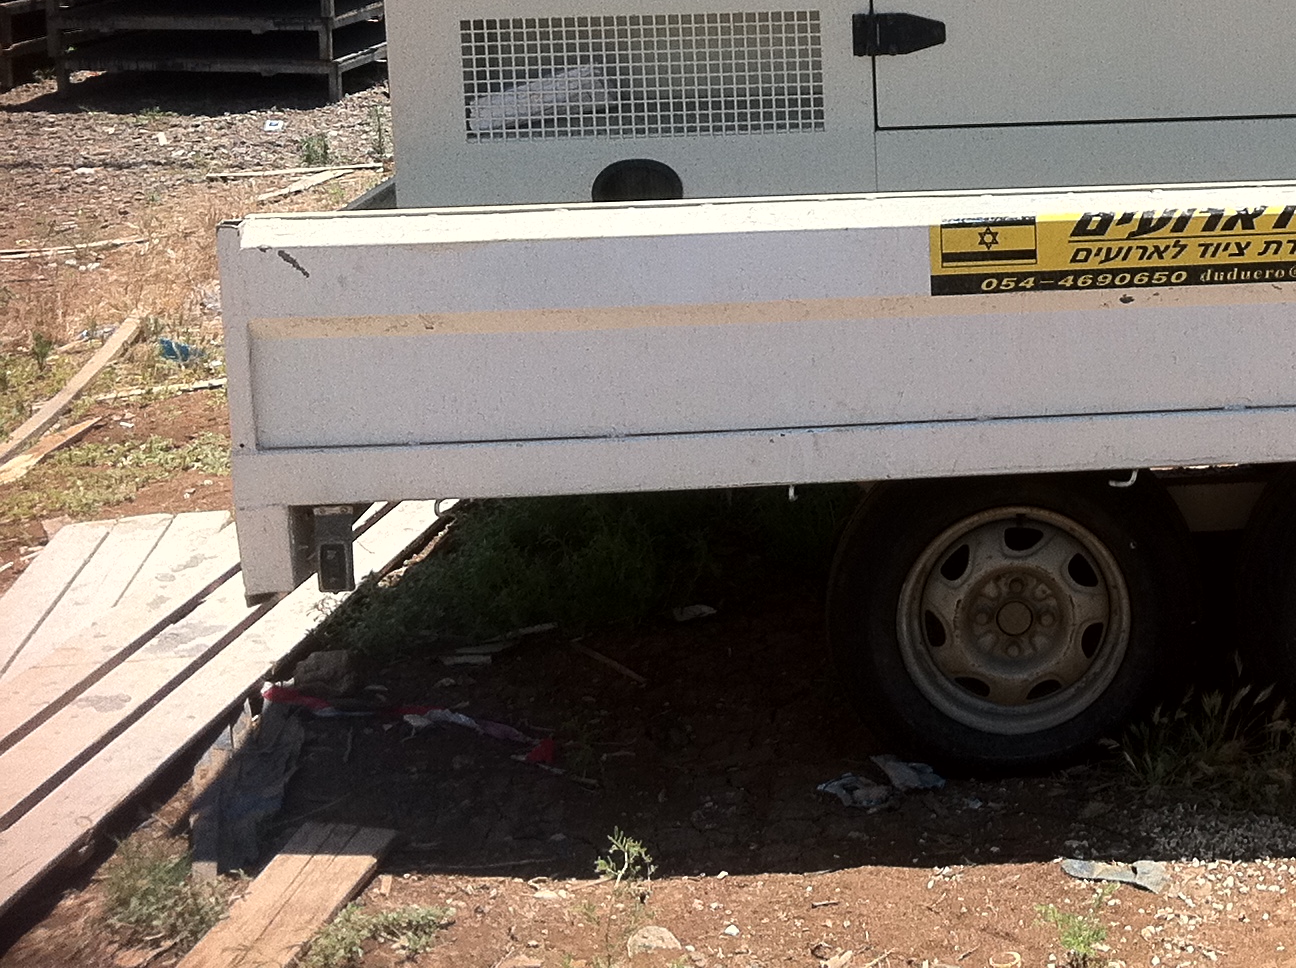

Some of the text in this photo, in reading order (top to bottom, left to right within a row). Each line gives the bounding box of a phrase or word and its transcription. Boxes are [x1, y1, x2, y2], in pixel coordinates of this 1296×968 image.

[1069, 205, 1268, 240] ארועים
[1069, 239, 1188, 265] לארועים
[1198, 241, 1252, 258] ציוד
[980, 271, 1188, 291] 054-4690650
